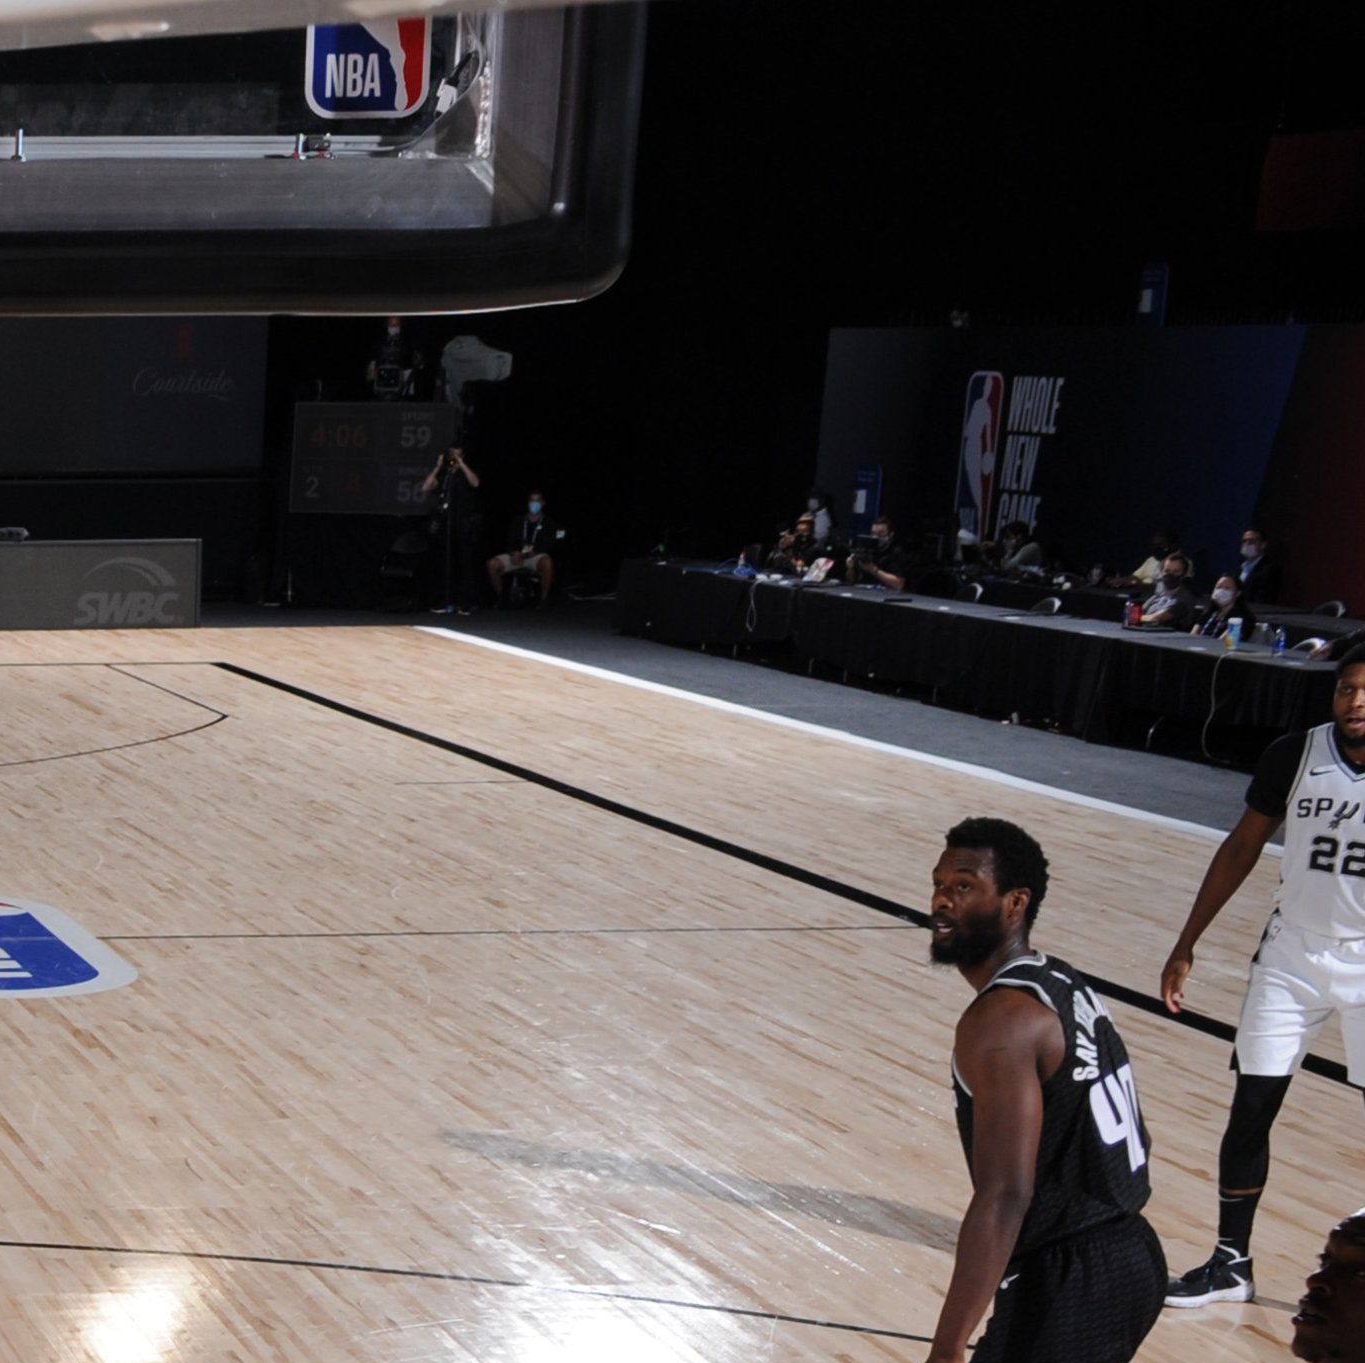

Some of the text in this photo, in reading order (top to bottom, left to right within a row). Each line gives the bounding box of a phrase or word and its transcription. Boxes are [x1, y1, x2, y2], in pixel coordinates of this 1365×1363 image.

[325, 53, 382, 98] NBA
[133, 366, 237, 401] Courtside
[1006, 375, 1066, 434] WHOLE
[309, 423, 368, 448] 4:06
[400, 425, 432, 448] 59
[999, 434, 1041, 492] NEW
[305, 476, 320, 498] 2
[73, 591, 181, 626] SWBC
[1310, 835, 1365, 877] 22
